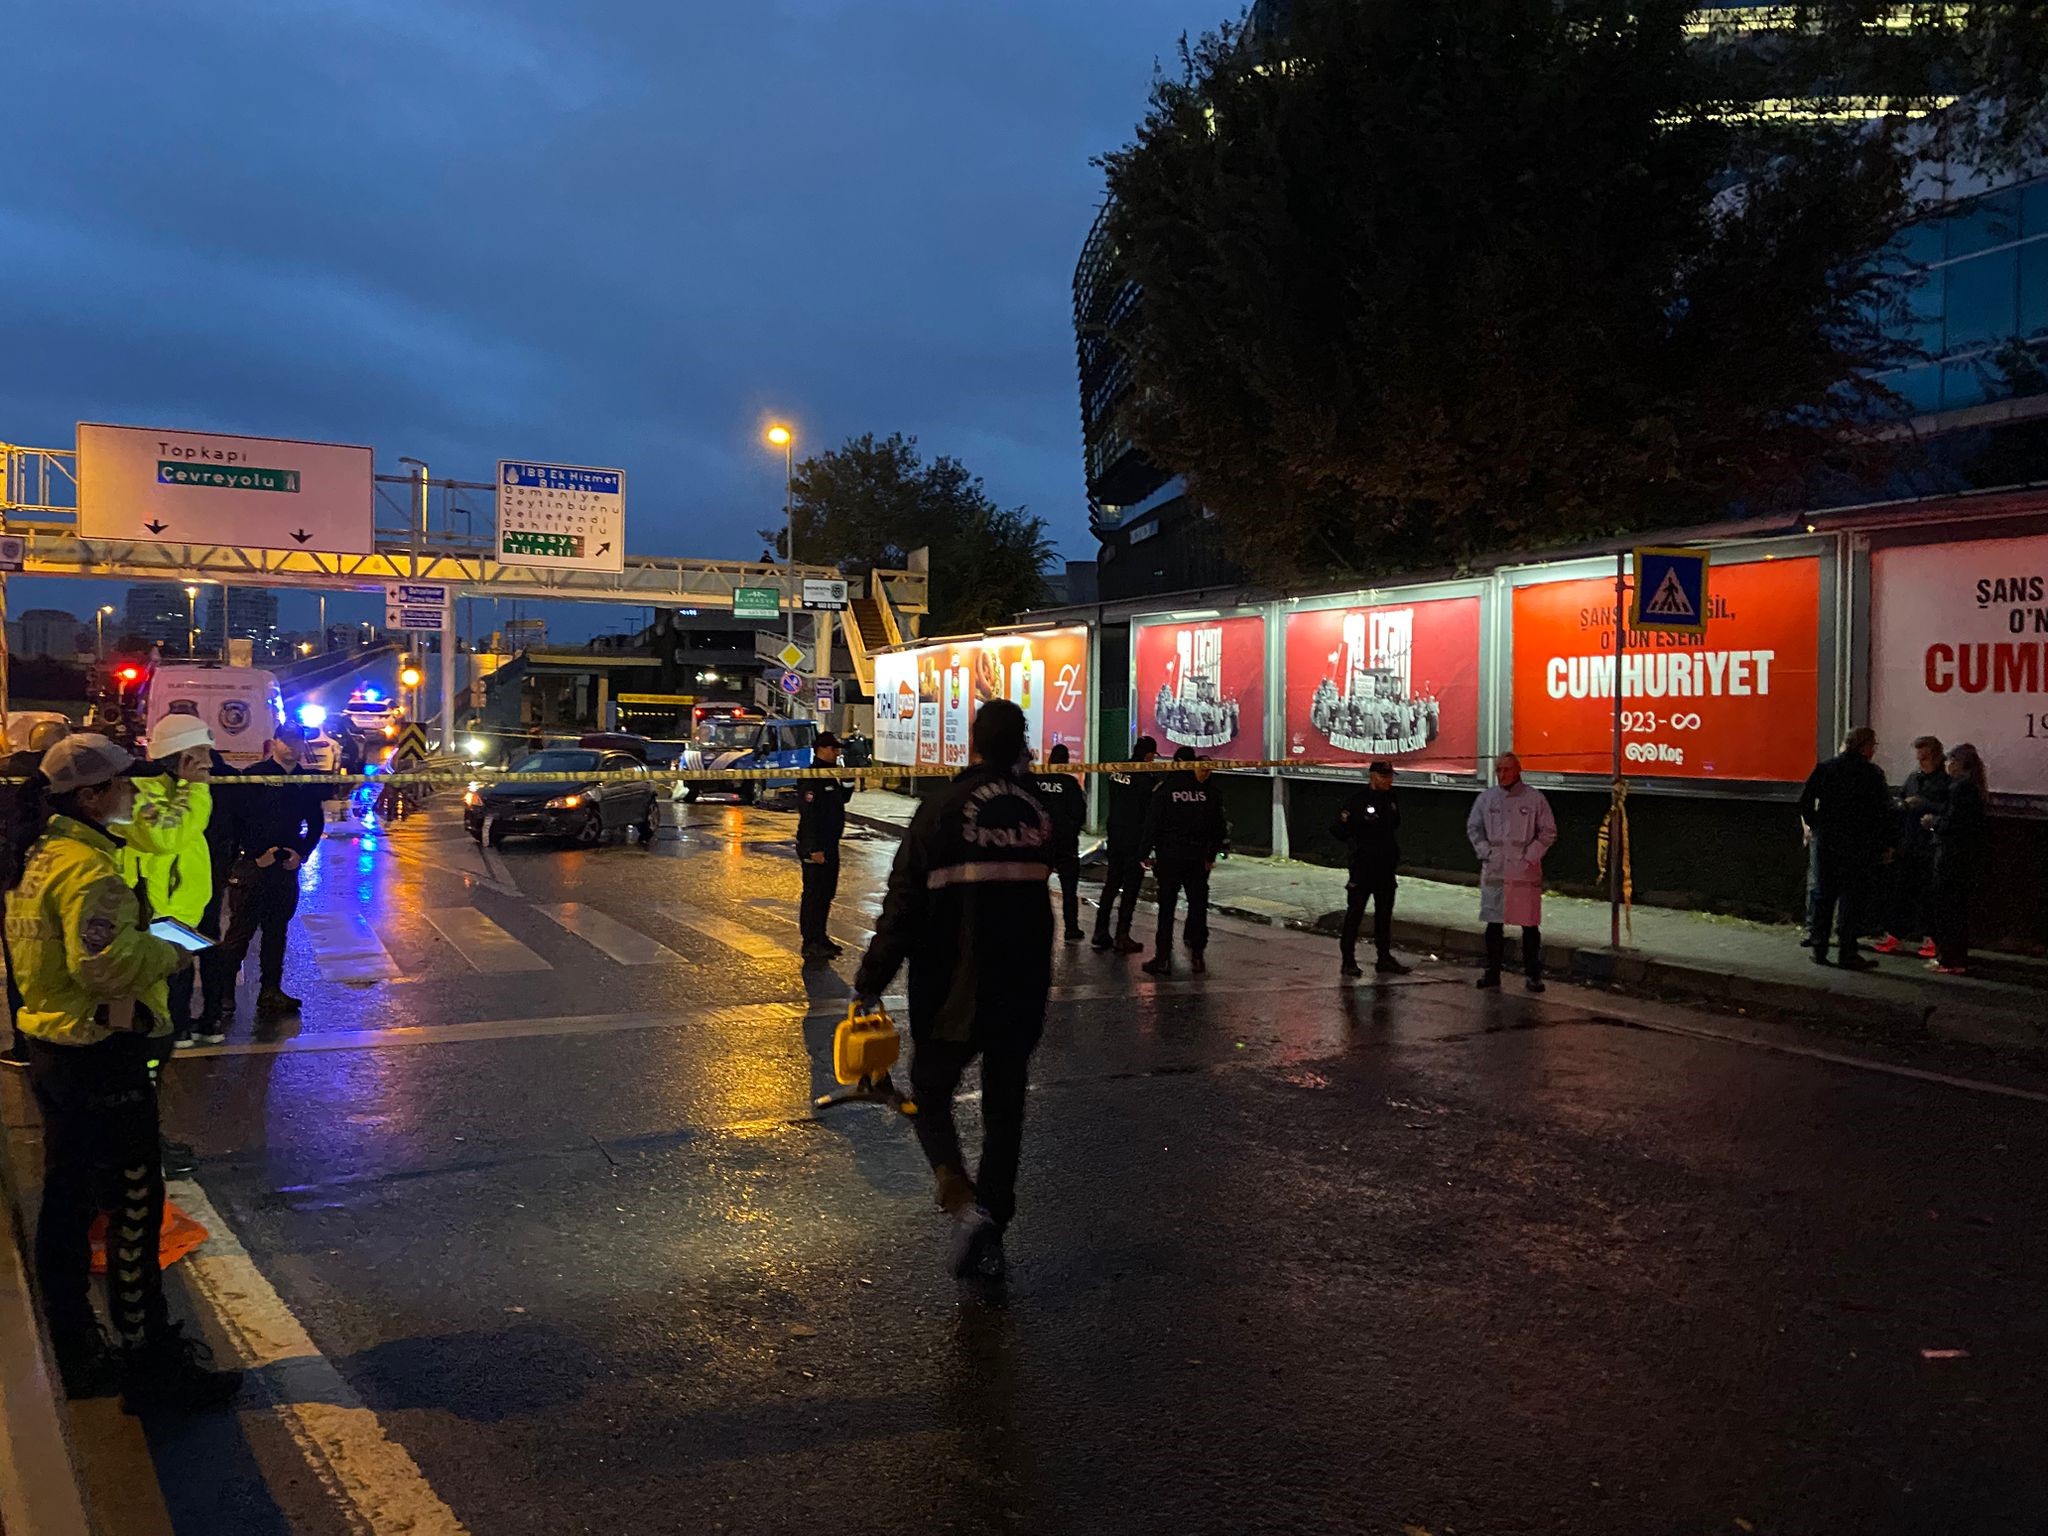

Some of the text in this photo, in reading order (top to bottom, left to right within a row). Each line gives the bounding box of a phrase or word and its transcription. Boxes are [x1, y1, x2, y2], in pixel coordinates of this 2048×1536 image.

[161, 466, 275, 488] Çevreyolu
[505, 497, 619, 514] Zeytinburnu
[503, 530, 579, 546] Avrasya
[1976, 576, 2044, 608] ŞANS
[1925, 641, 2048, 694] CUM
